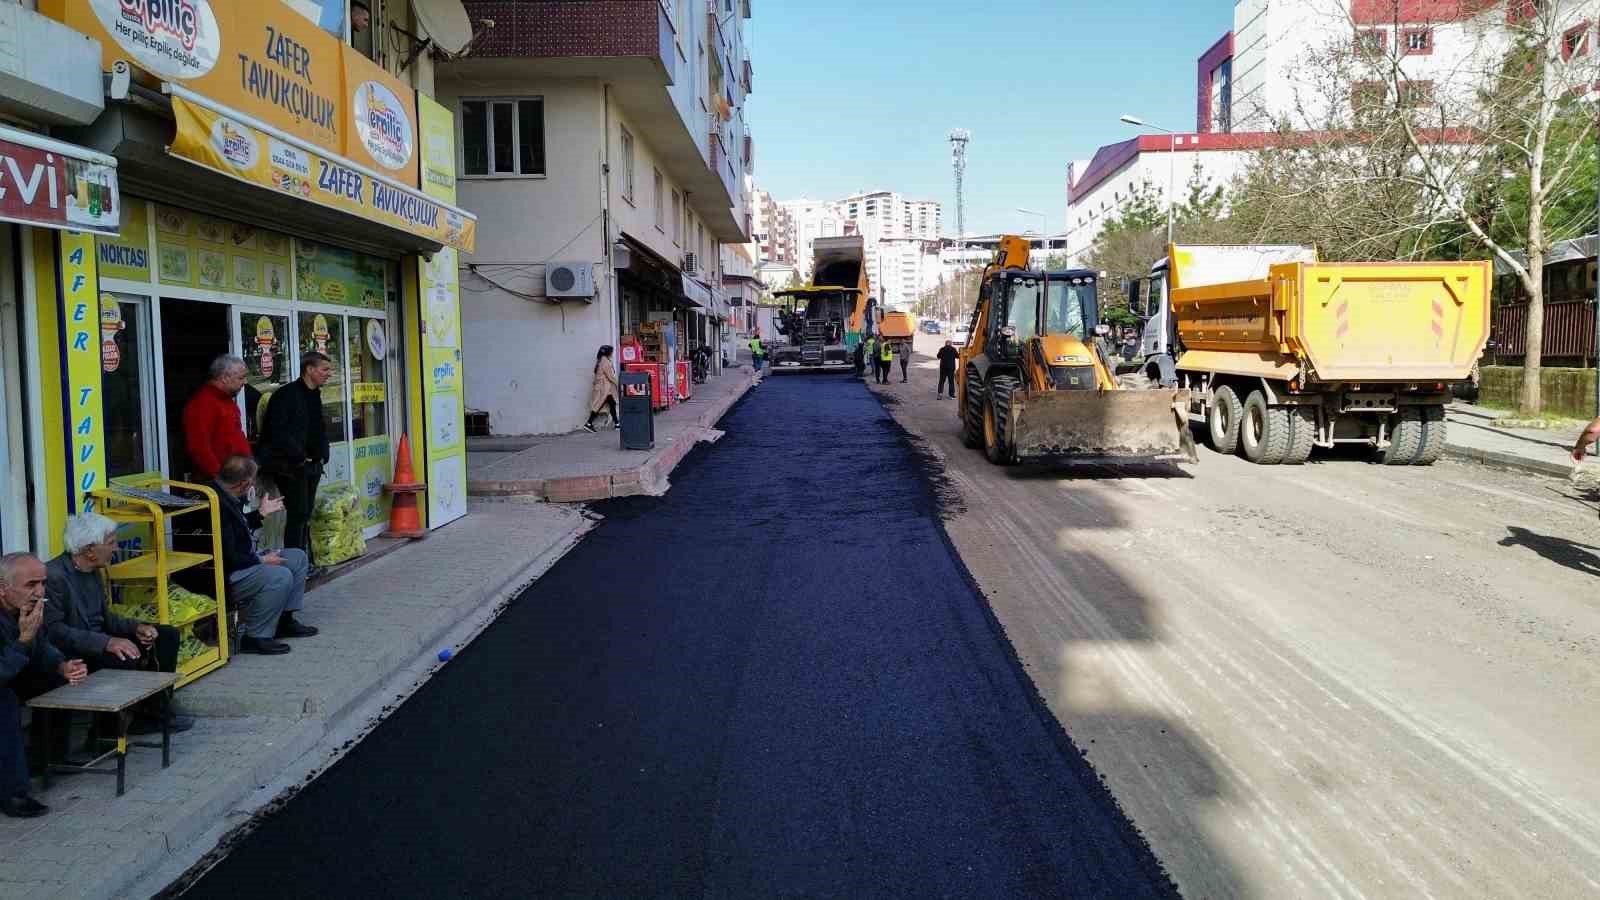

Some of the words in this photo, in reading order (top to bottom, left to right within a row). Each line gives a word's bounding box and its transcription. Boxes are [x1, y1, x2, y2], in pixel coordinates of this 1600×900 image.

[116, 19, 131, 36] Her
[132, 30, 149, 48] piliç
[150, 36, 173, 59] Erpiliç
[173, 47, 200, 69] değildir
[123, 0, 195, 43] piliç
[265, 25, 313, 85] ZAFER
[238, 53, 337, 135] TAVUKÇULUK
[318, 159, 364, 205] ZAFER
[370, 179, 440, 231] TAVUKÇULUK
[100, 243, 148, 268] NOKTASI
[69, 229, 89, 352] AFER
